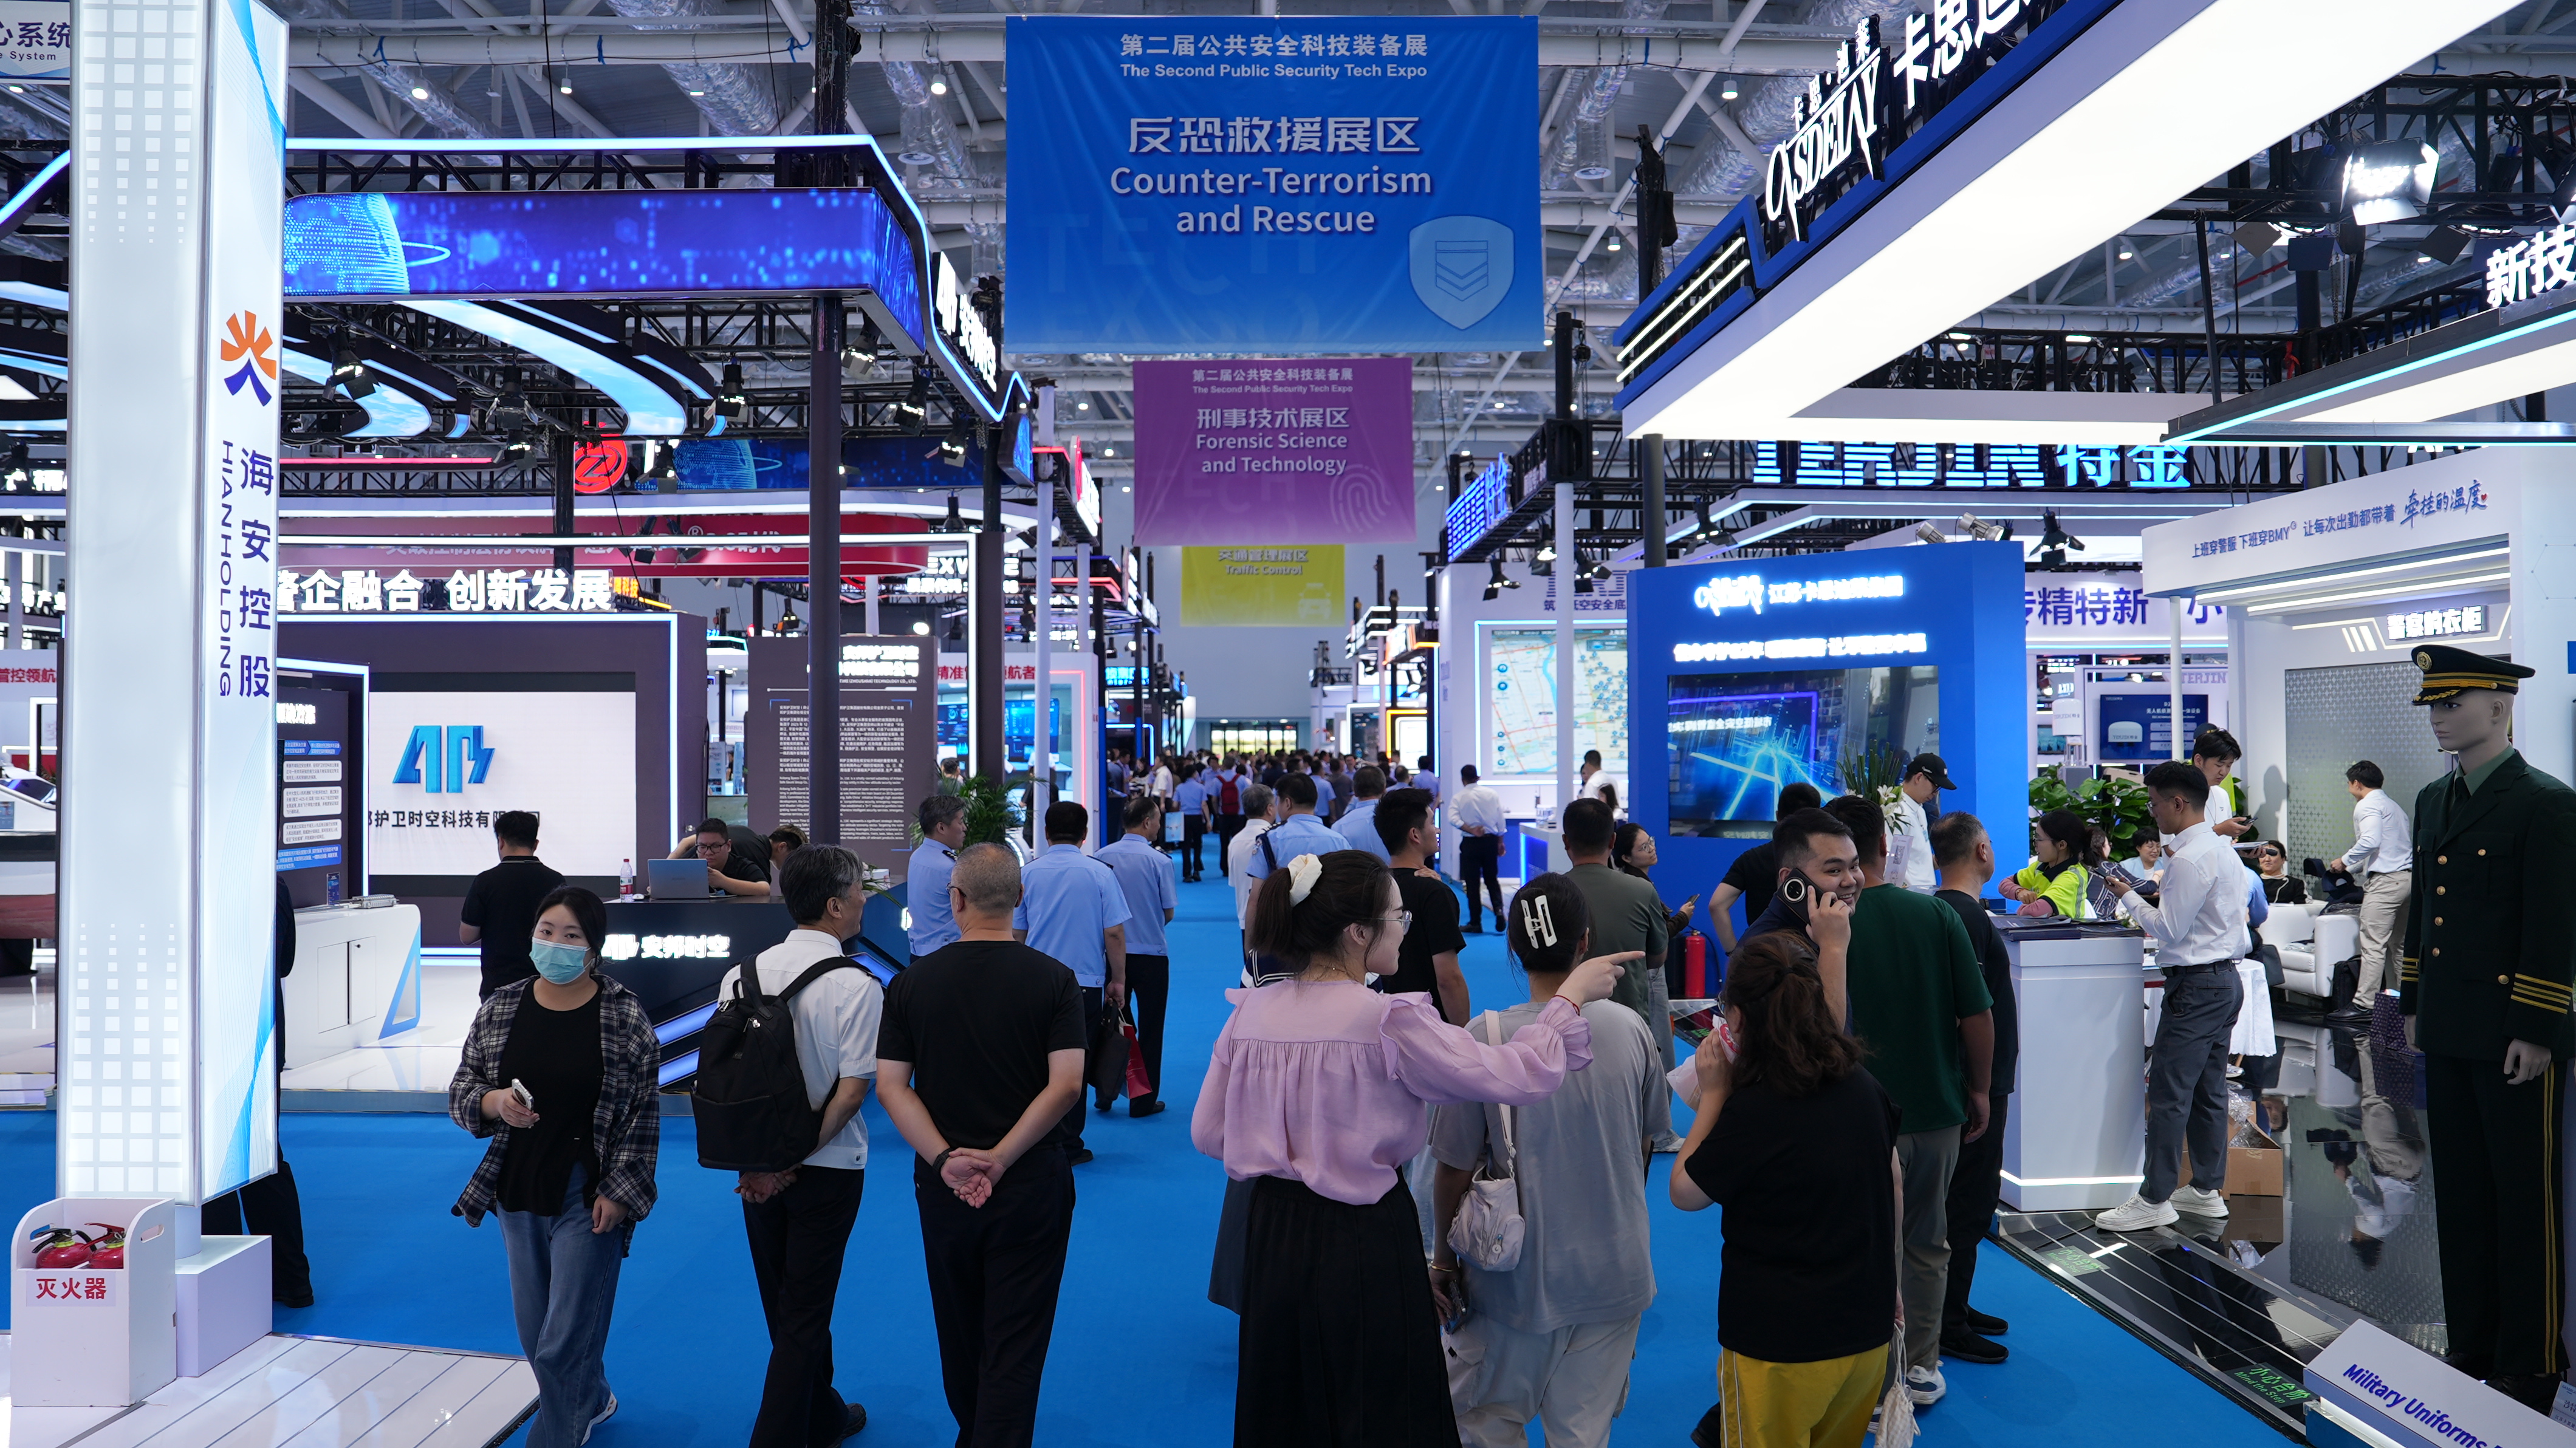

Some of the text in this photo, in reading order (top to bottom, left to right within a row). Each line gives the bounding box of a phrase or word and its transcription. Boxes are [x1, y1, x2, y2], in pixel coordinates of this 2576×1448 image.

[10, 50, 56, 61] System
[1120, 33, 1428, 58] 第二届公共安全科技装备展
[1120, 63, 1428, 80] The Second Public Security Tech Expo
[1129, 117, 1421, 153] 反恐救援展区
[1110, 166, 1432, 195] Counter-Terrorism
[1177, 205, 1375, 233] and Rescue
[1193, 368, 1353, 382] 第二届公共安全科技装备展
[1193, 386, 1208, 394] The
[1211, 385, 1241, 394] Second
[1273, 385, 1307, 395] Security
[1310, 384, 1329, 393] Tech
[1331, 384, 1353, 395] Expo
[1197, 408, 1349, 429] 刑事技术展区
[1196, 433, 1348, 449] Forensic Science
[1202, 456, 1346, 476] and Technology
[2400, 479, 2487, 529] 牵挂的温度
[2191, 536, 2237, 558] 上班穿警服
[2303, 504, 2395, 537] 让每次出勤都带着
[1218, 549, 1308, 562] 交通管理展区
[239, 449, 273, 698] 海安控股
[1224, 564, 1303, 575] Traffic Control
[445, 568, 612, 612] 创新发展
[1544, 599, 1626, 611] 筑空安全底
[2386, 606, 2482, 640] 警察的衣柜
[938, 665, 1035, 681] 精准航者
[369, 810, 540, 828] 护卫时空科技有限
[641, 934, 730, 958] 安邦时空
[2058, 1249, 2100, 1271] 小心台阶
[2067, 1264, 2081, 1274] Step
[36, 1277, 107, 1300] 灭火器
[2234, 1371, 2286, 1404] Mind the Step
[2249, 1368, 2311, 1401] 小心台阶
[2343, 1364, 2488, 1448] Military Uniforms
